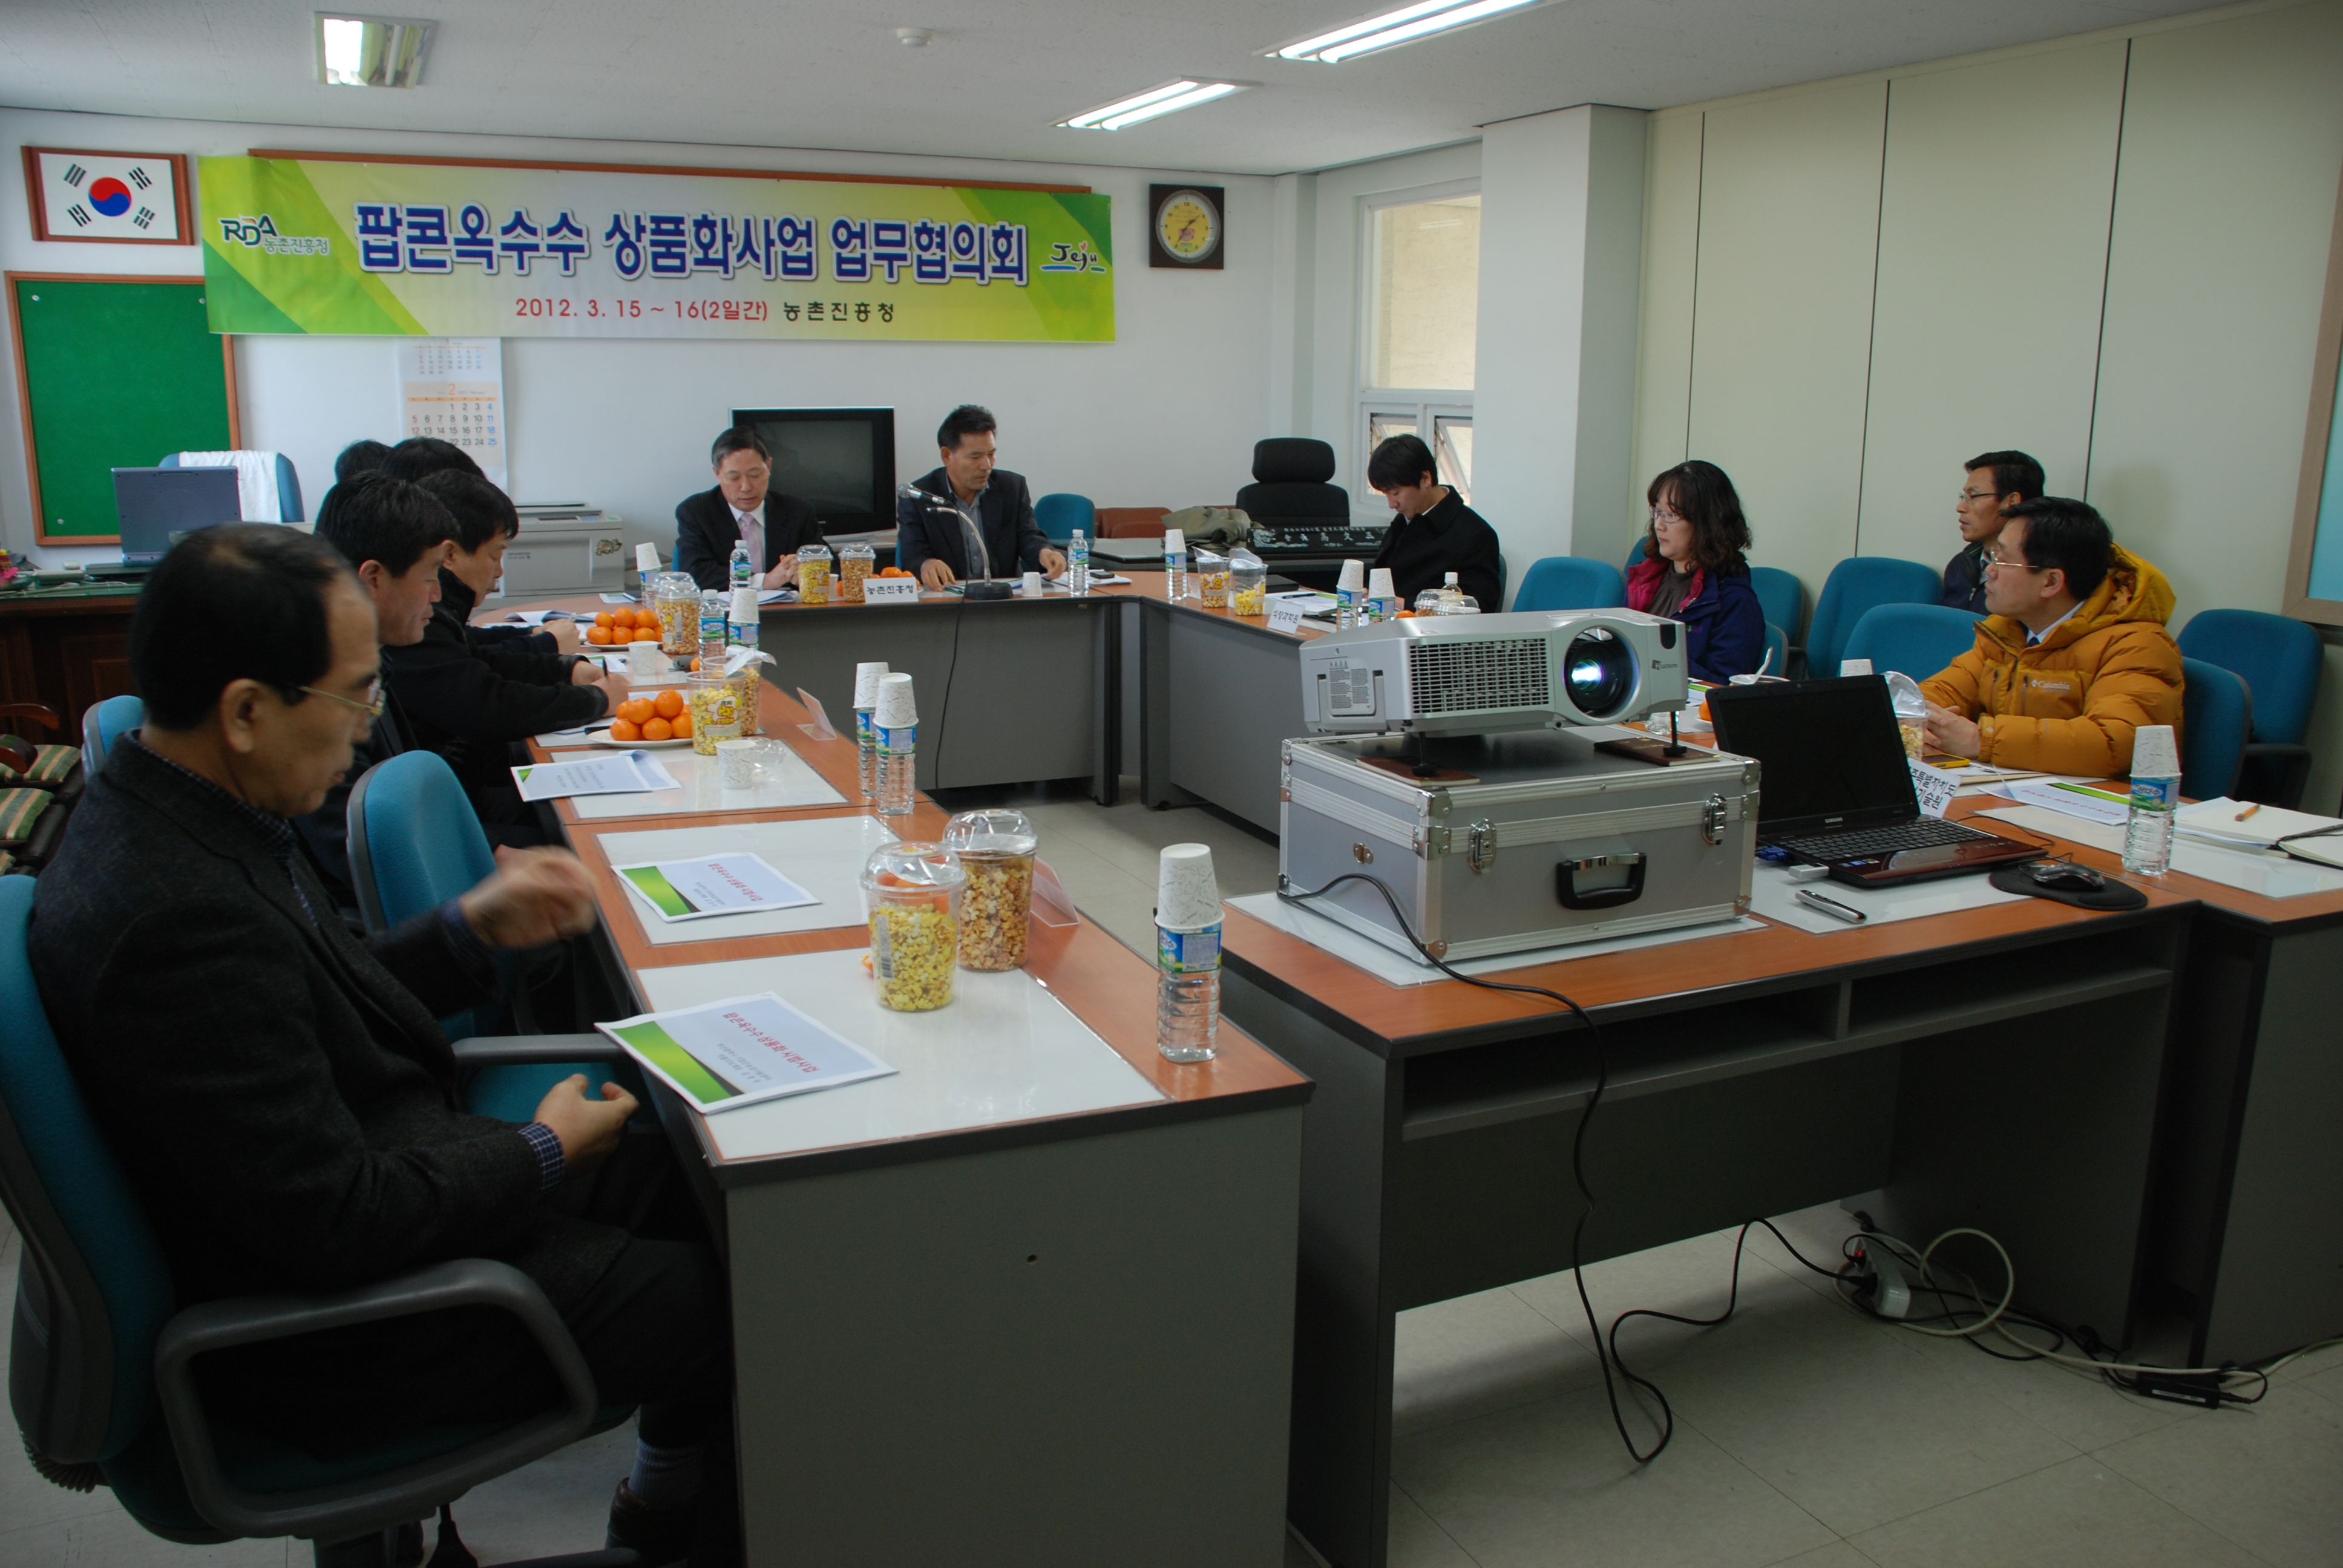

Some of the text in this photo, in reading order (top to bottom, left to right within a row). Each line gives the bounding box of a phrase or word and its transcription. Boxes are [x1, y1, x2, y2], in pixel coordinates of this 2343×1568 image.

[220, 214, 278, 246] RDA
[264, 237, 329, 255] 농촌진흥청
[356, 204, 1024, 282] 팝콘옥수수 상품화사업 업무협의회
[516, 298, 578, 317] 2012.
[587, 299, 606, 318] 3.
[616, 299, 641, 318] 15
[674, 300, 768, 322] 16(2일간)
[783, 301, 894, 323] 농촌진흥청
[448, 384, 456, 395] 2
[867, 585, 914, 595] 농촌진흥청
[2037, 681, 2070, 690] Columbia
[1911, 766, 1956, 797] 주특별자치도
[1916, 787, 1943, 810] 기술원
[723, 1011, 764, 1037] 팝콘옥수수
